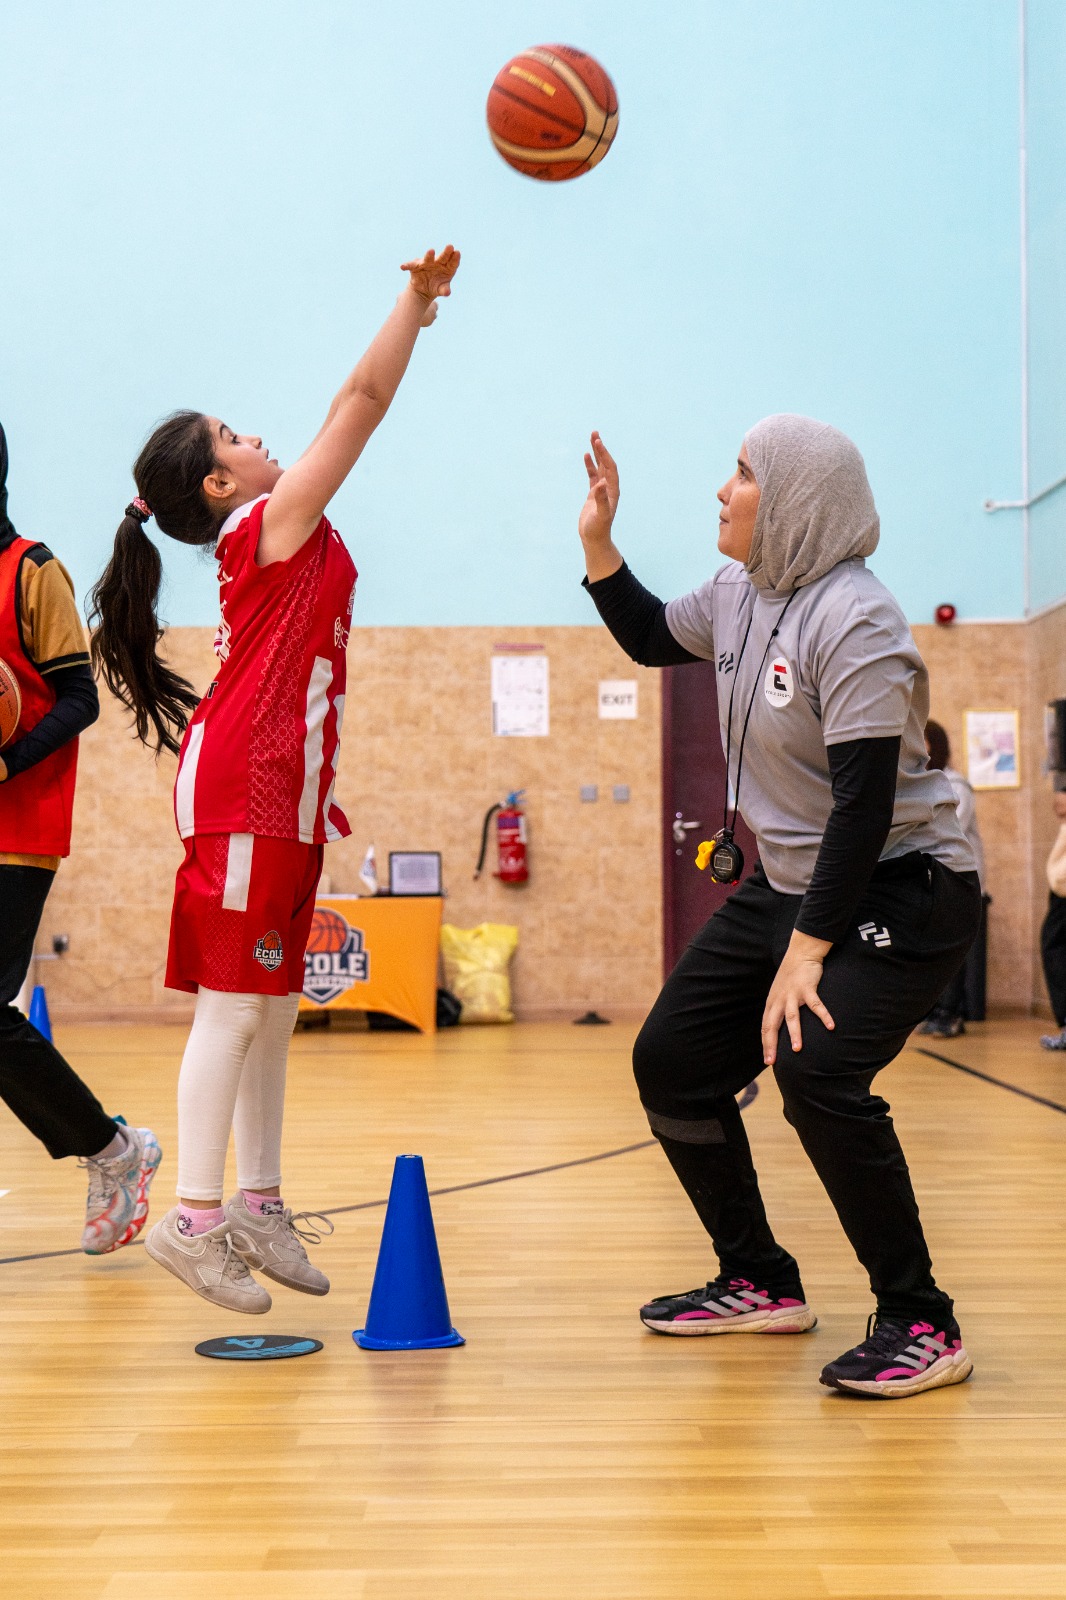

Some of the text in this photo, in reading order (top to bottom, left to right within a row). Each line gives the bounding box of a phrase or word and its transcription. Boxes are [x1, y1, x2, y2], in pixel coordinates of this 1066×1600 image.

[601, 693, 633, 706] EXIT
[255, 947, 283, 959] ECOLE
[303, 952, 365, 977] COLE
